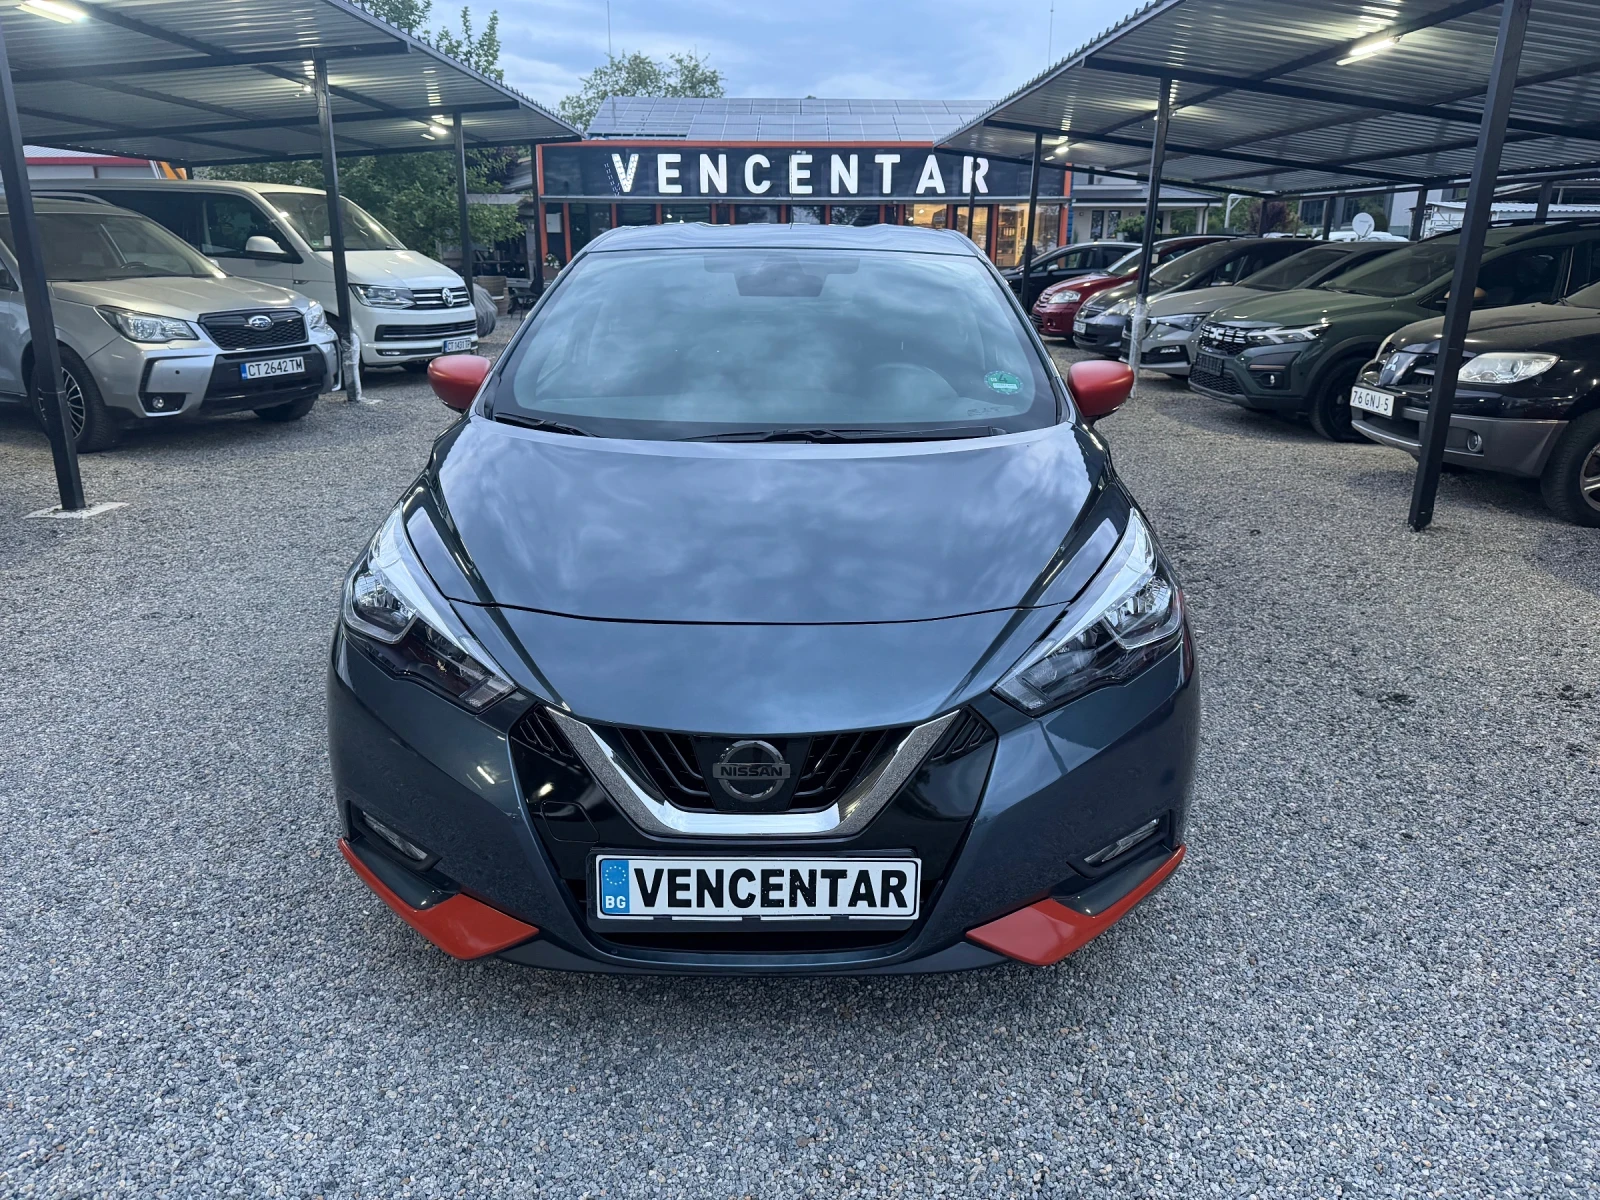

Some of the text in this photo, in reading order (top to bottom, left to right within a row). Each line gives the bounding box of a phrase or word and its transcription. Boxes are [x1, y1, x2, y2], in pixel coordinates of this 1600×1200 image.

[611, 153, 989, 194] VENCENTAR
[248, 363, 261, 377] CT
[263, 360, 288, 375] 2642
[289, 358, 303, 371] TM
[720, 766, 783, 777] NISSAN
[605, 867, 908, 909] BG VENCENTAR
